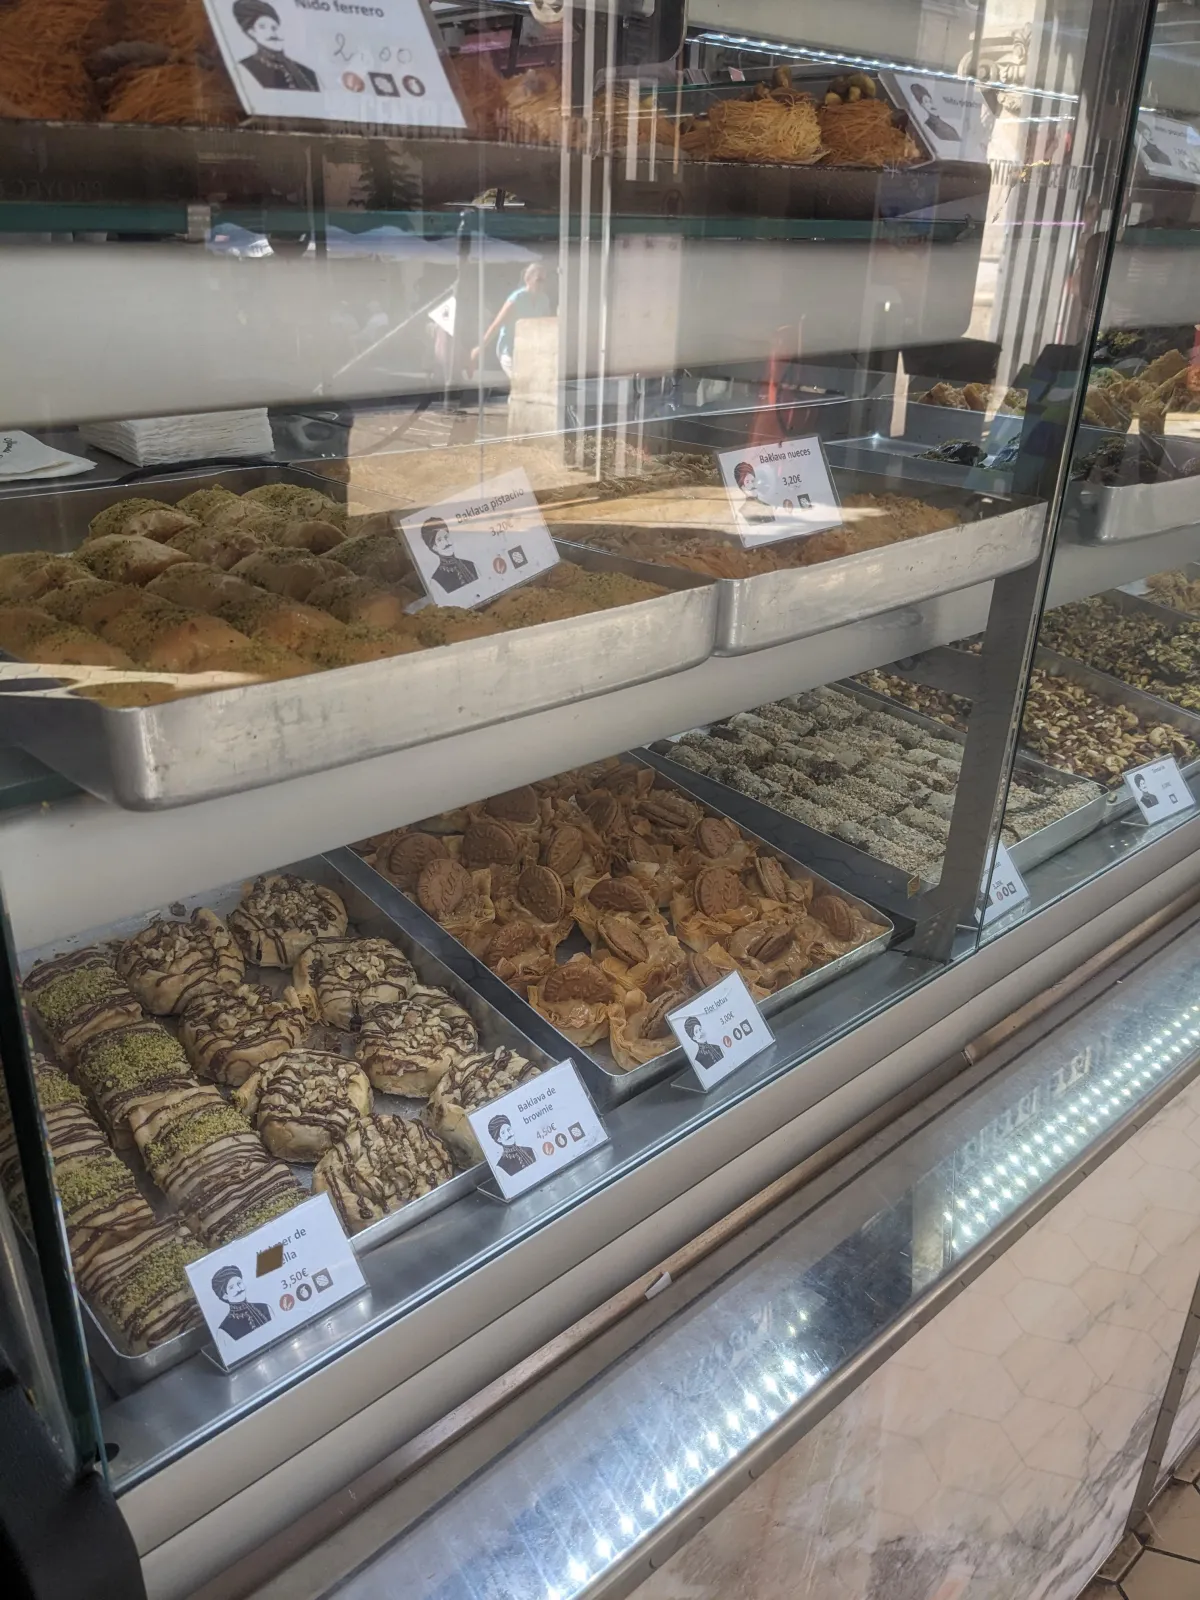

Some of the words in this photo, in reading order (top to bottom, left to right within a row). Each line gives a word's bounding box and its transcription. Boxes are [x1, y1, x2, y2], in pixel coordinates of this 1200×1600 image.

[333, 0, 385, 18] ferrero
[759, 451, 787, 464] Baklava
[787, 448, 811, 459] nueces
[782, 474, 802, 486] 3,20€
[455, 503, 490, 524] Baklava
[490, 488, 524, 511] pistacho
[489, 521, 514, 537] 3,20€
[517, 1093, 546, 1112] Baklava
[546, 1087, 557, 1097] de
[523, 1104, 554, 1124] brownie
[536, 1122, 557, 1139] 4,50€
[294, 1228, 306, 1239] de
[281, 1268, 308, 1289] 3,50€
